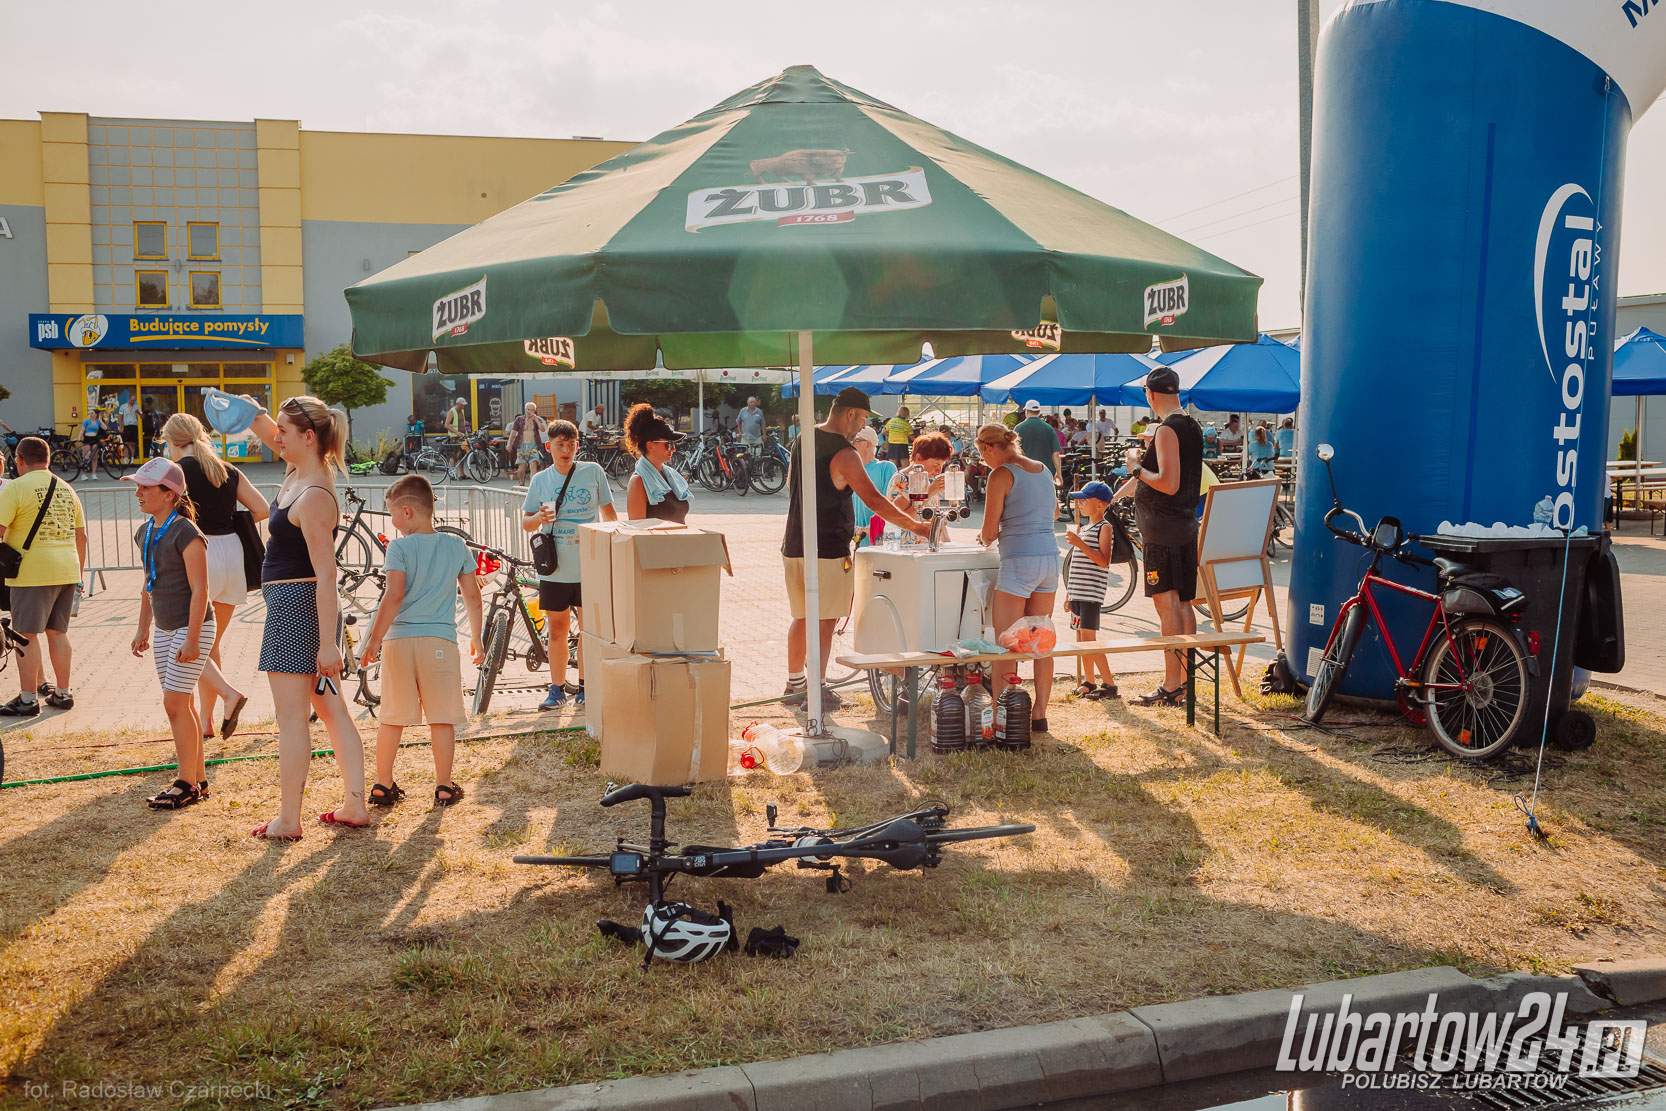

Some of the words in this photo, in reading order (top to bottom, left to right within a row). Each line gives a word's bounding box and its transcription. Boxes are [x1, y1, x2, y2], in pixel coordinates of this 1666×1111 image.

[703, 179, 921, 219] ŻUBR
[793, 213, 839, 223] 1768
[436, 289, 483, 330] ŻUBR
[1147, 284, 1186, 318] ŻUBR
[37, 319, 59, 342] psb
[204, 317, 270, 335] pomysły
